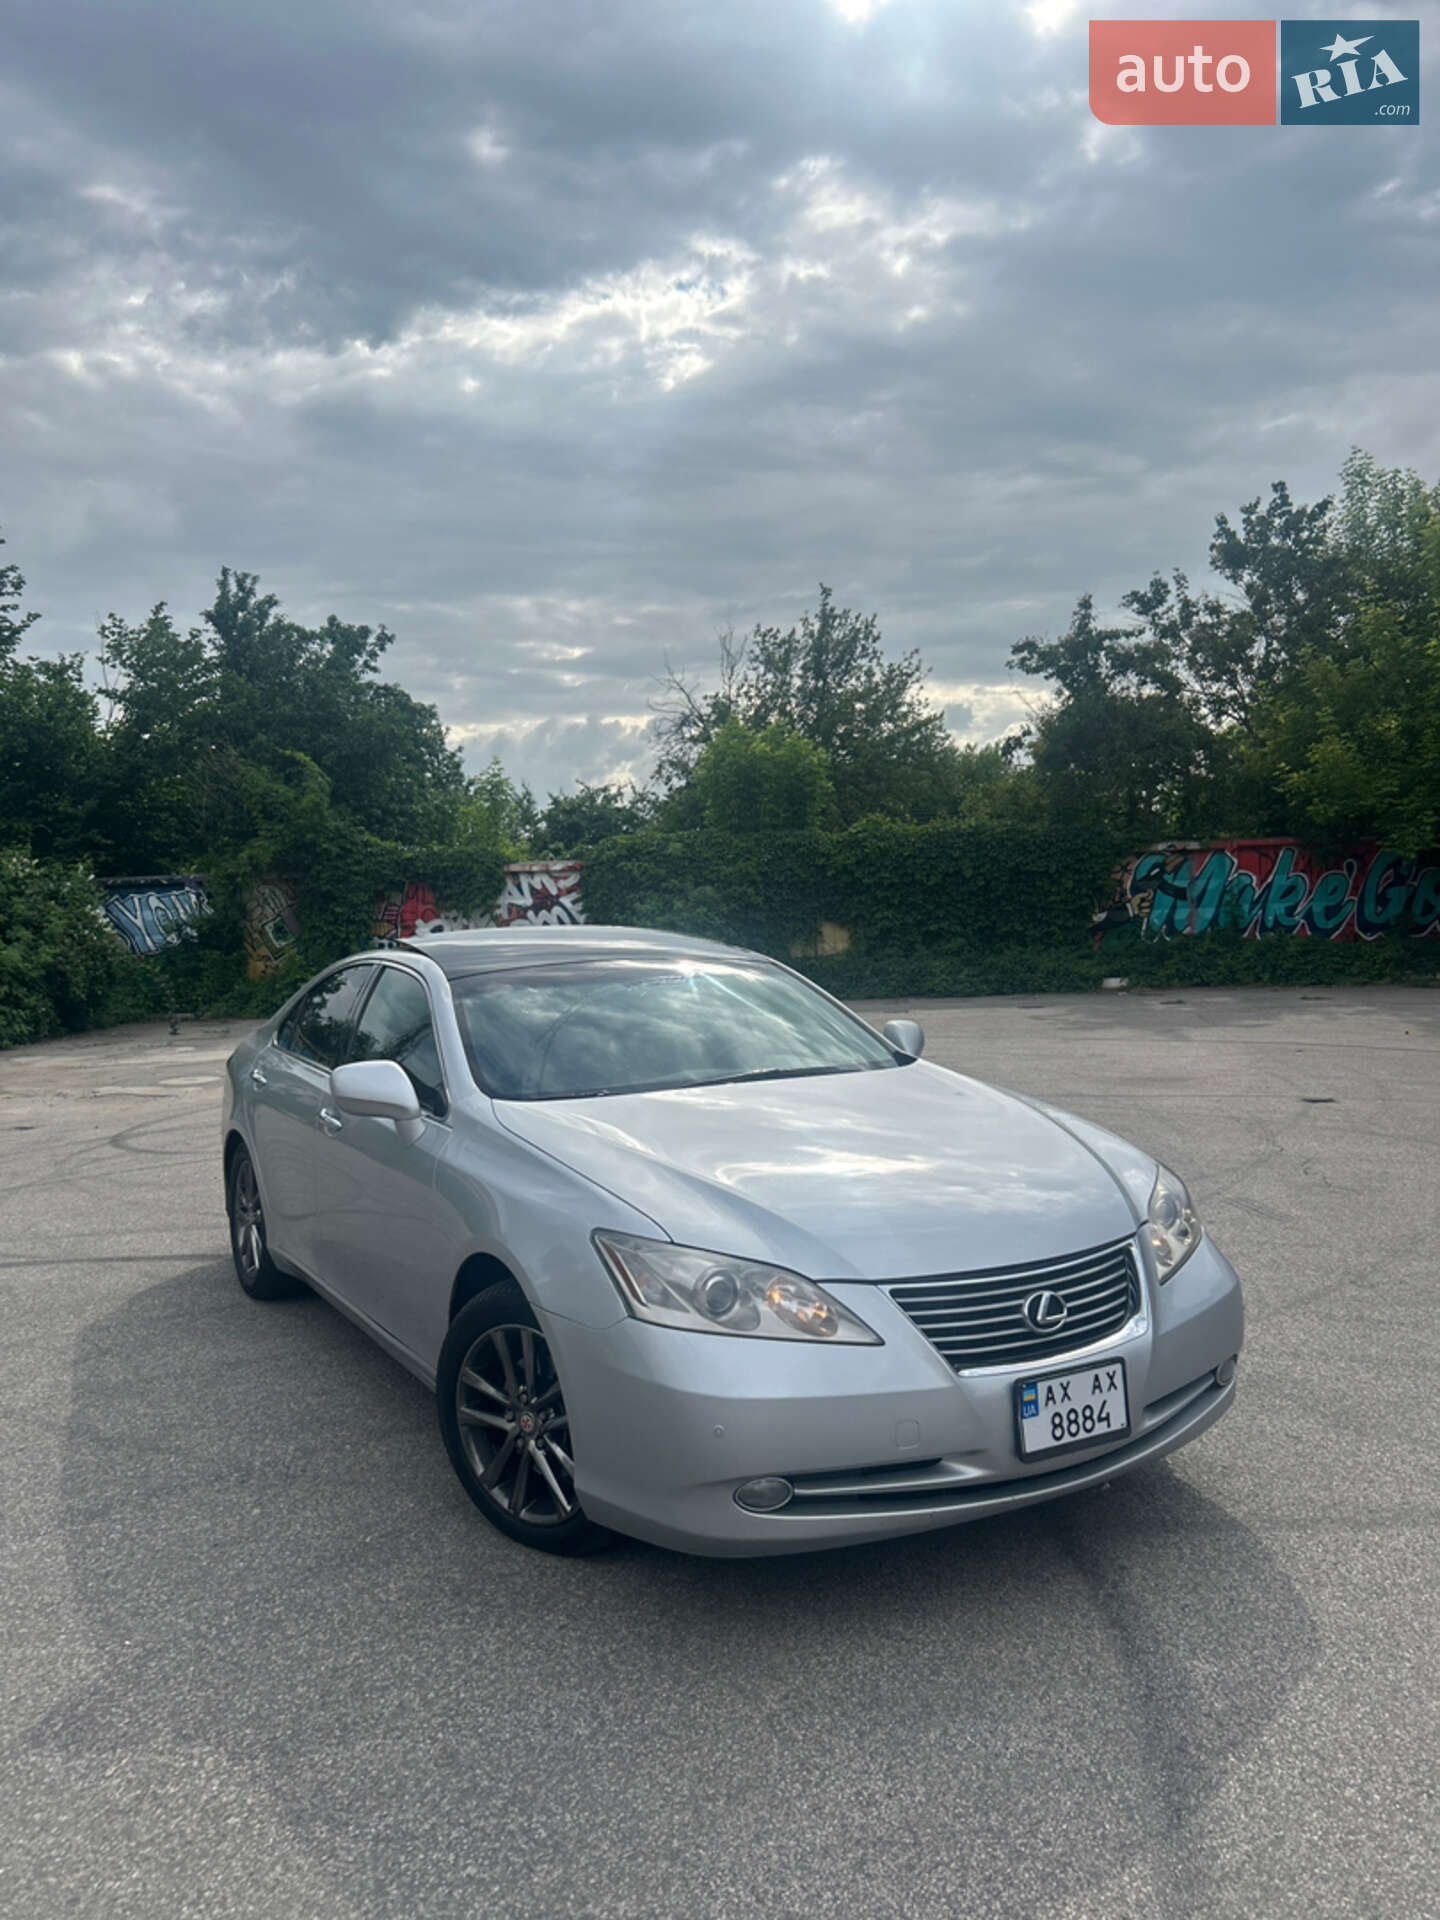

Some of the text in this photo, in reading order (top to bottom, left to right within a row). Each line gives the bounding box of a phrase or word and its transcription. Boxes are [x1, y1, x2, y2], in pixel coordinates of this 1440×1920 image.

[1045, 1370, 1118, 1407] AX AX
[1051, 1399, 1111, 1441] 8884
